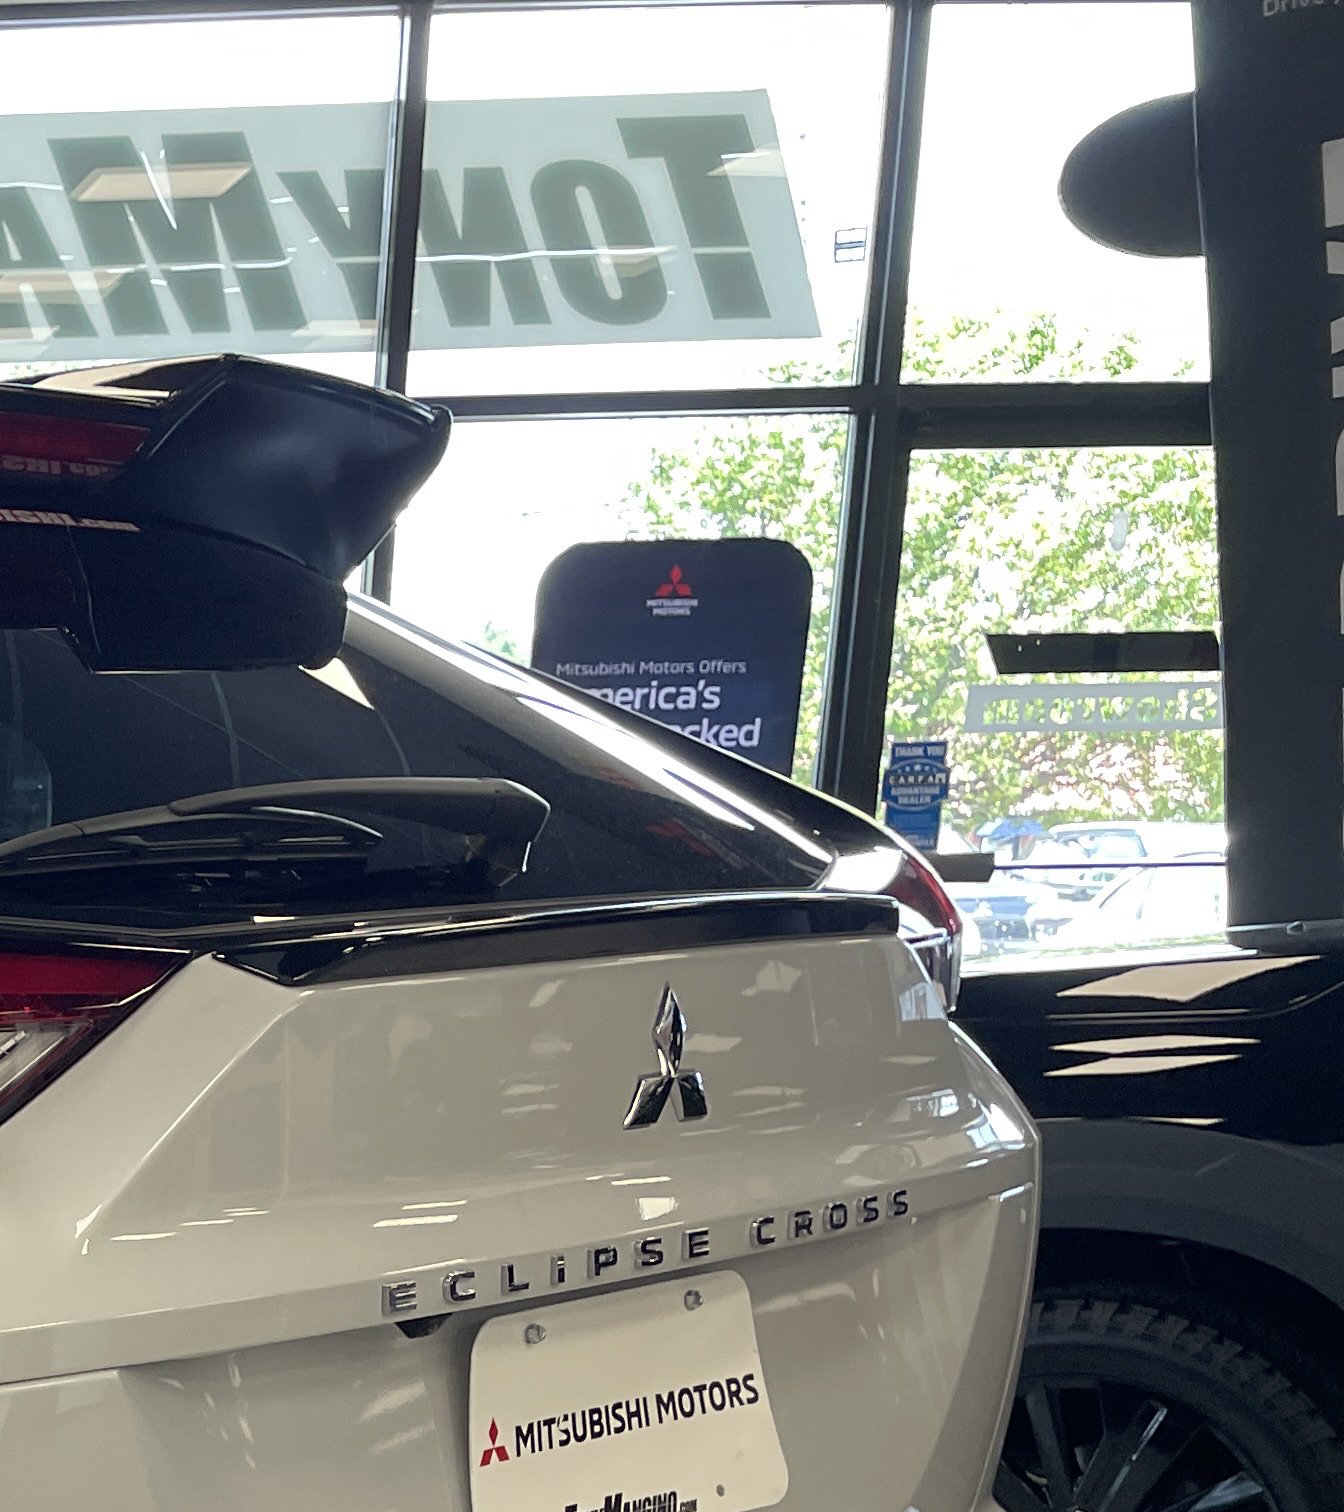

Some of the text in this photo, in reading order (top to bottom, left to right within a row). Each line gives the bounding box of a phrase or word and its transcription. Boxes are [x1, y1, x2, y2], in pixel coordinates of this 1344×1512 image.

[555, 659, 748, 676] Mitsubishi Motors Offers
[381, 1189, 910, 1316] ECLIPSE CROSS
[515, 1373, 760, 1460] MITSUBISHI MOTORS
